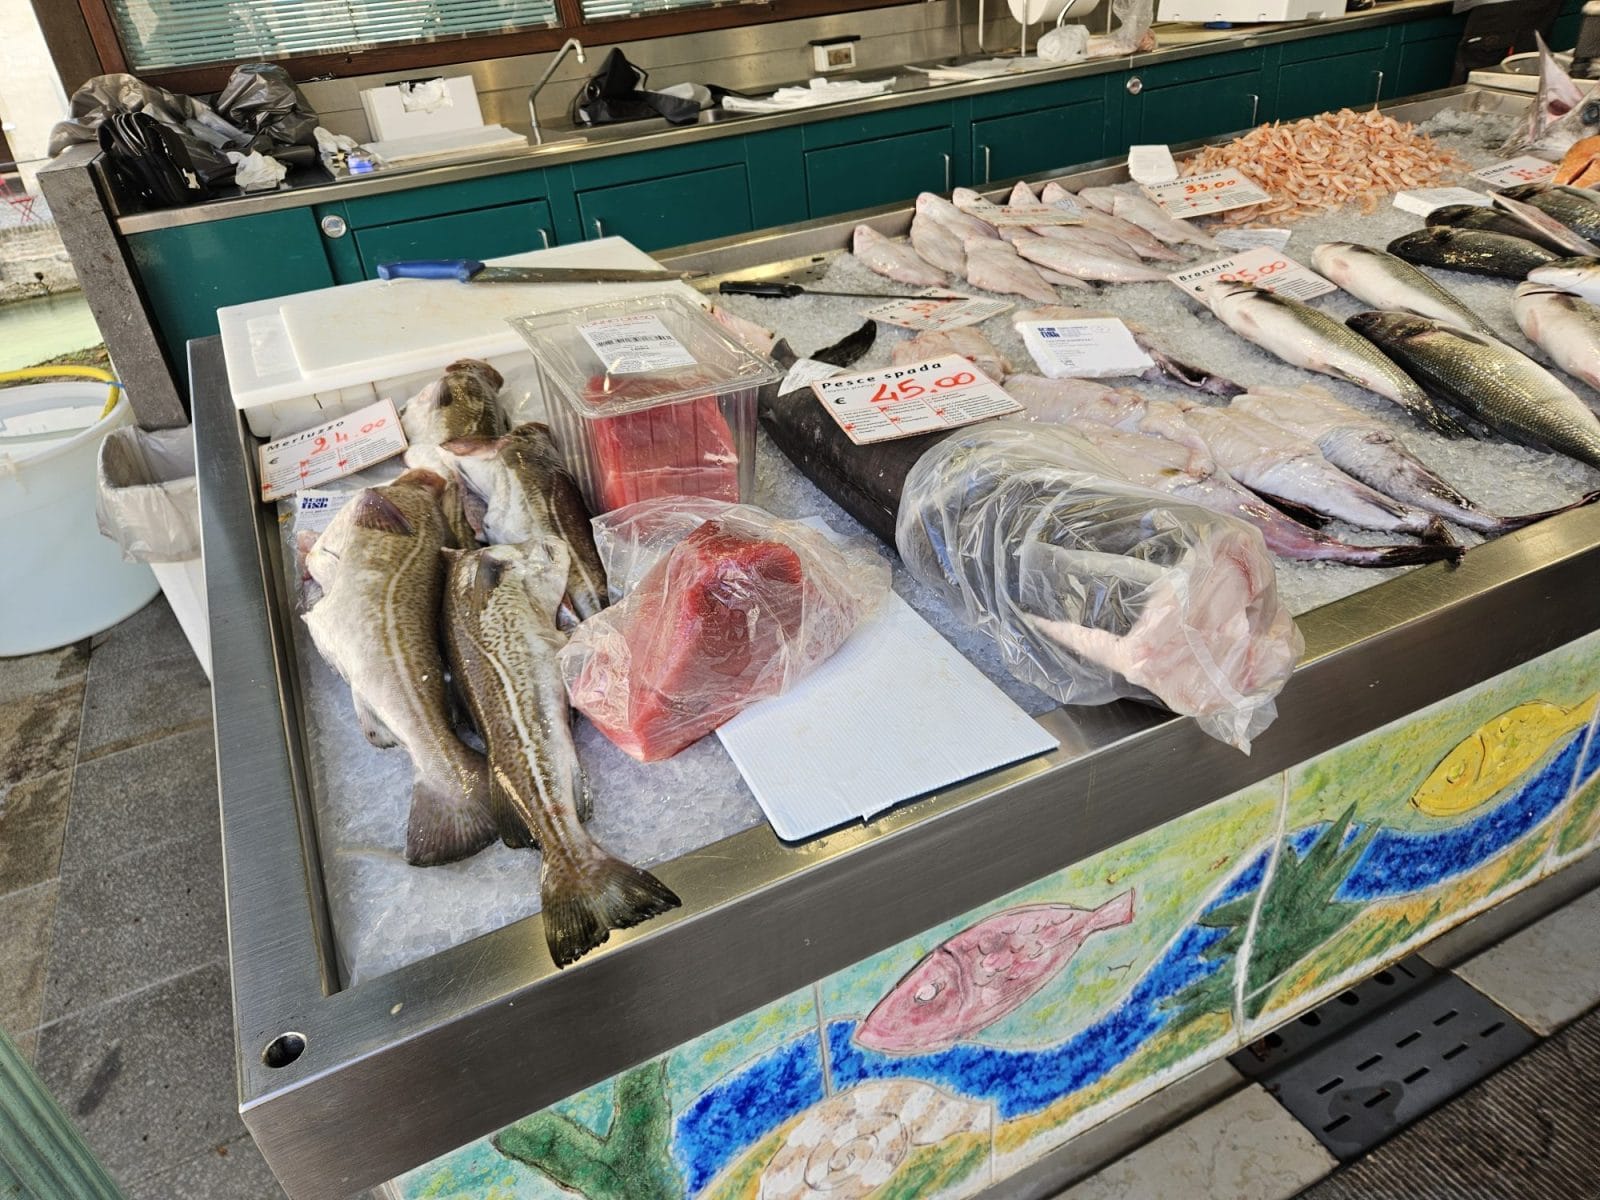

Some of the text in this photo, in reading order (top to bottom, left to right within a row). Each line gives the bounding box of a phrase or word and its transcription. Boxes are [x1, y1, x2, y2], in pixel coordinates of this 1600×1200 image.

[1194, 285, 1204, 293] €
[822, 375, 876, 389] Pesce
[884, 362, 942, 379] spada
[834, 397, 846, 405] €
[870, 371, 976, 403] 45.00
[267, 420, 345, 452] Merluzzo
[268, 456, 279, 465] €
